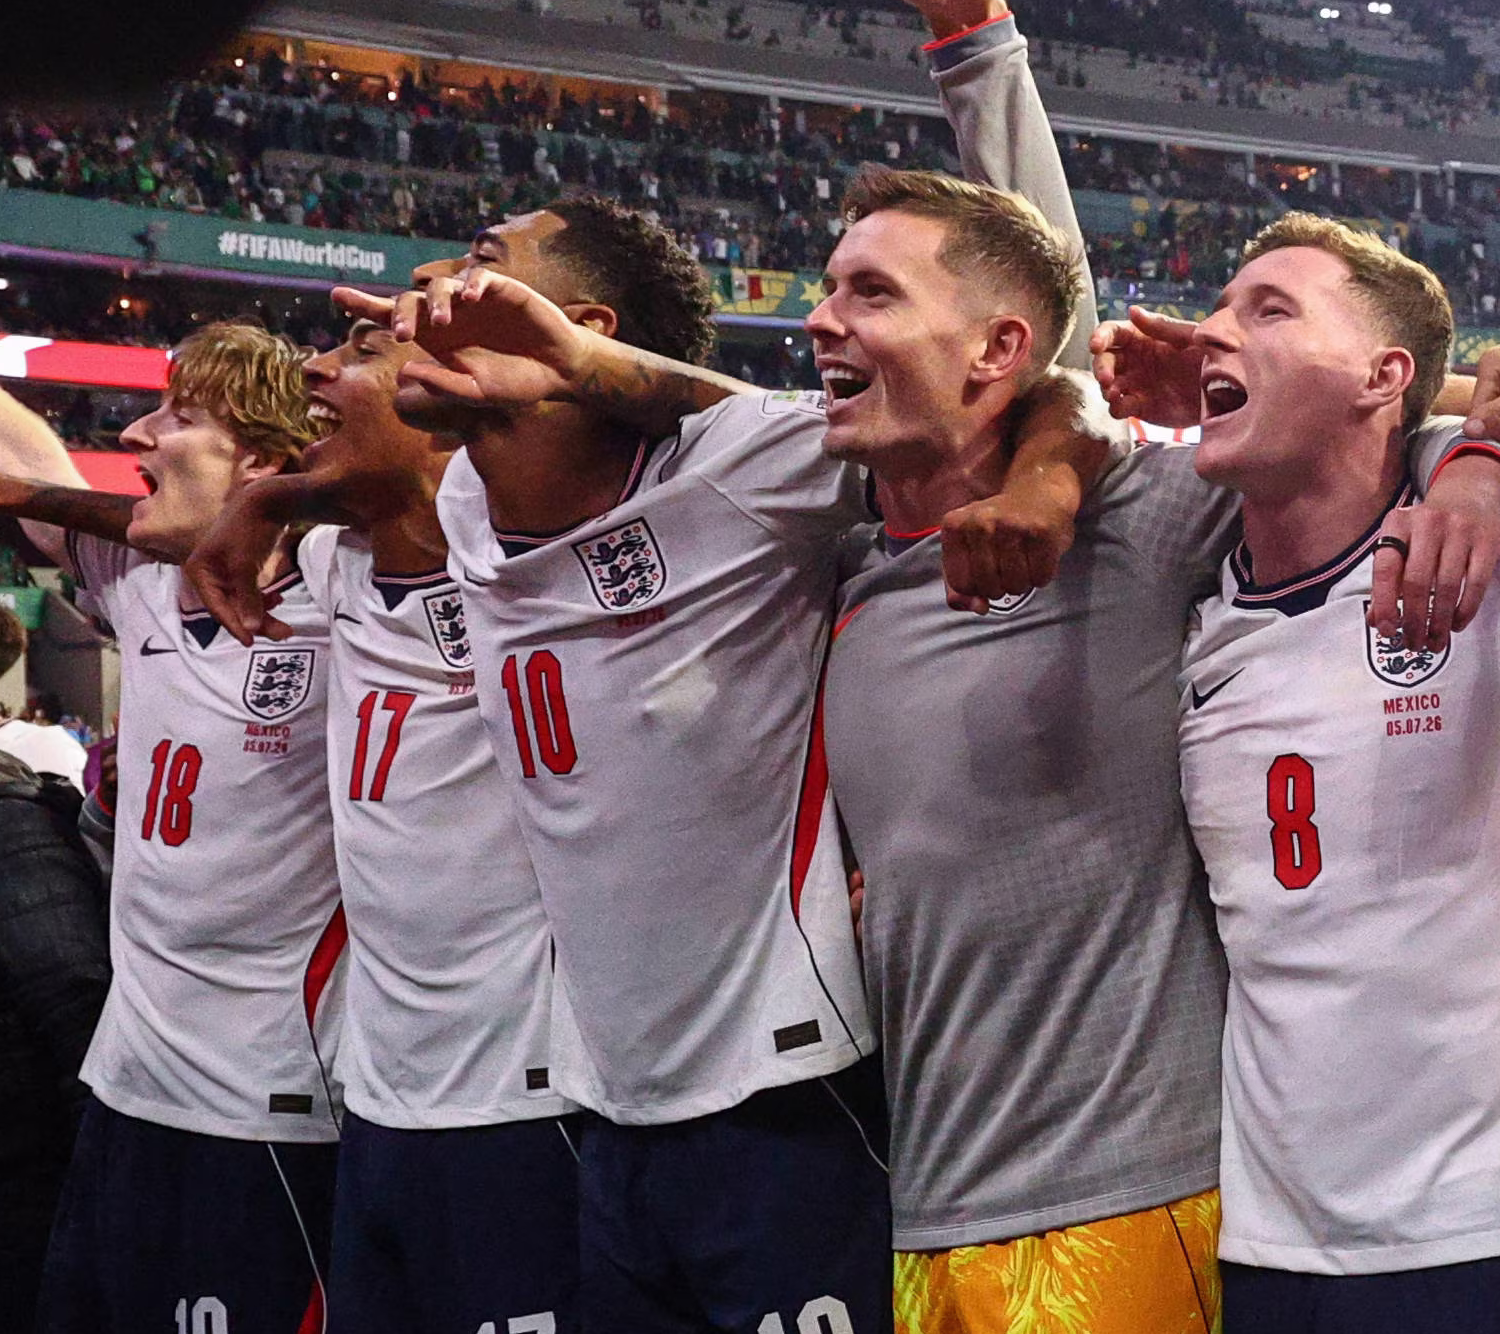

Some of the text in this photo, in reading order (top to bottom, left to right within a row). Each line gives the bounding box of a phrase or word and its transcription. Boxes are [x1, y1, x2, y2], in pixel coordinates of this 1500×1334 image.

[218, 231, 385, 275] #FIFAWorldCup
[348, 689, 417, 803] 17
[500, 649, 578, 779] 10
[1383, 693, 1440, 715] MEXICO
[1386, 715, 1443, 737] 05.07.26
[140, 739, 204, 847] 18
[1266, 753, 1324, 891] 8
